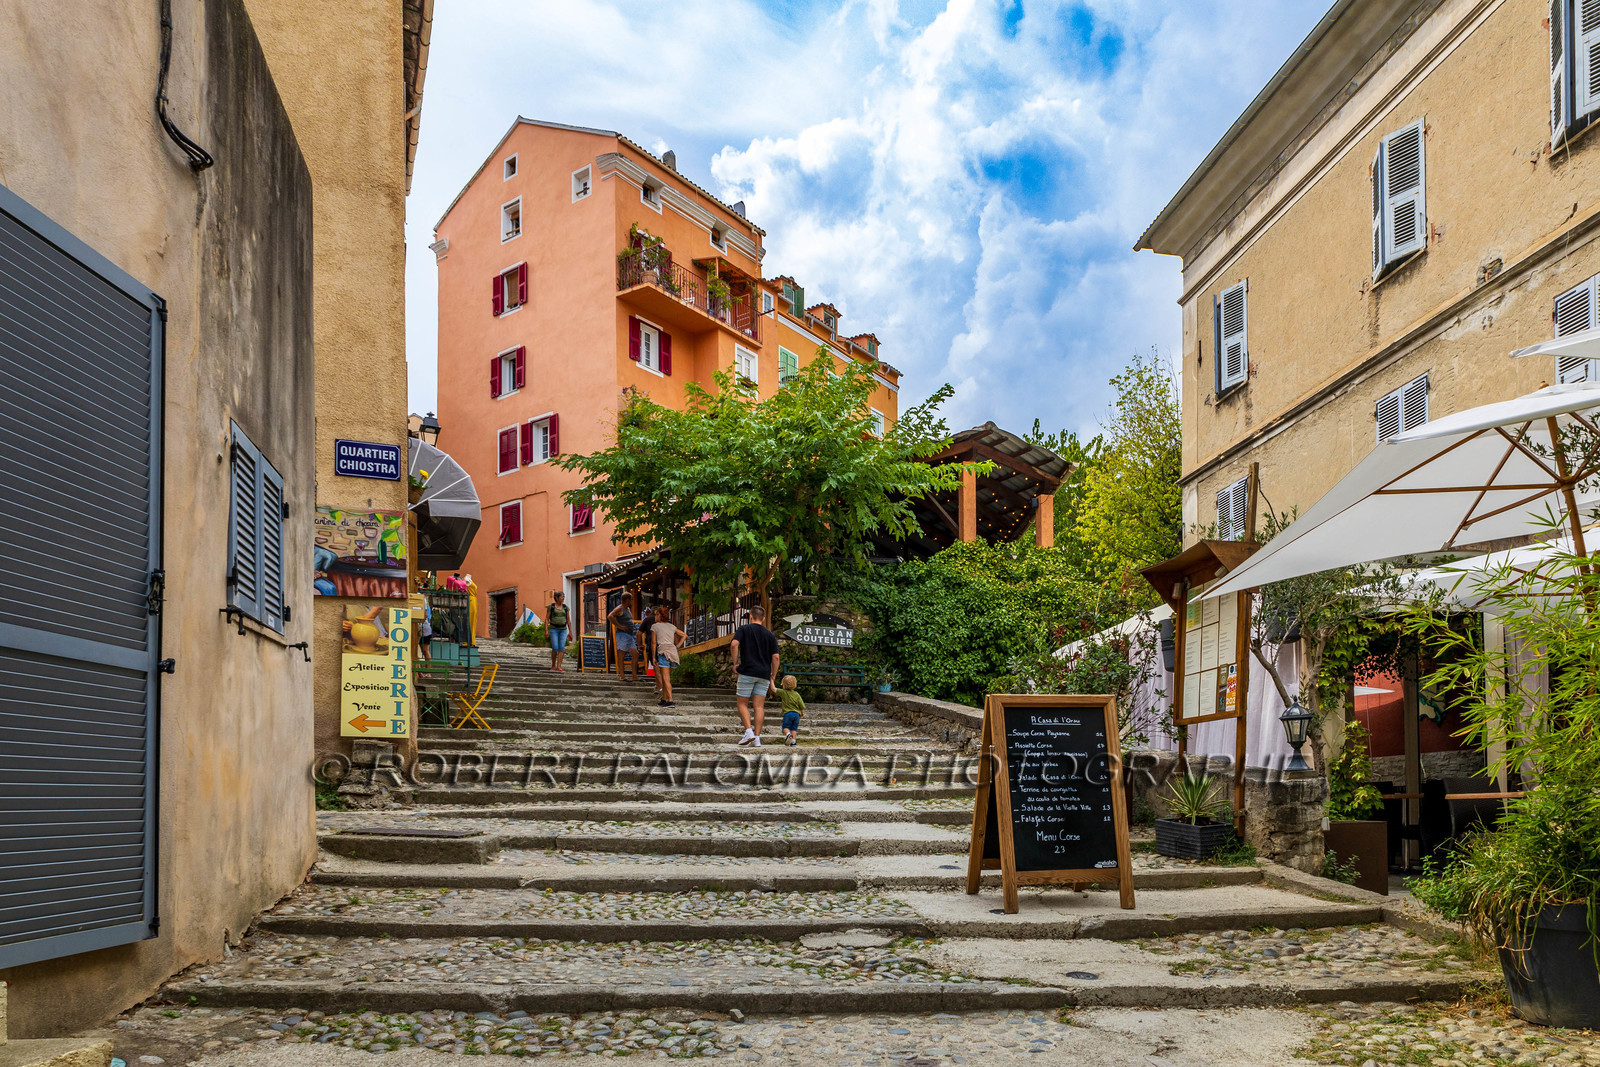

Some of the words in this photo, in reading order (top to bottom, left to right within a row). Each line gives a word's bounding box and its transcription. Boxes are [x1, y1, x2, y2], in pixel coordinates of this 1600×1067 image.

[340, 446, 396, 460] QUARTIER
[340, 459, 396, 474] CHIOSTRA
[314, 517, 336, 526] antina
[796, 627, 852, 638] ARTISAN
[796, 634, 852, 646] COUTELIER
[349, 663, 385, 671] Atelier
[390, 609, 409, 735] POTERIE
[343, 682, 389, 691] Exposition
[352, 702, 381, 711] Vente
[1013, 729, 1029, 738] Soupe
[1036, 831, 1057, 841] Menu
[1059, 829, 1081, 841] Corse
[1054, 845, 1066, 853] 23
